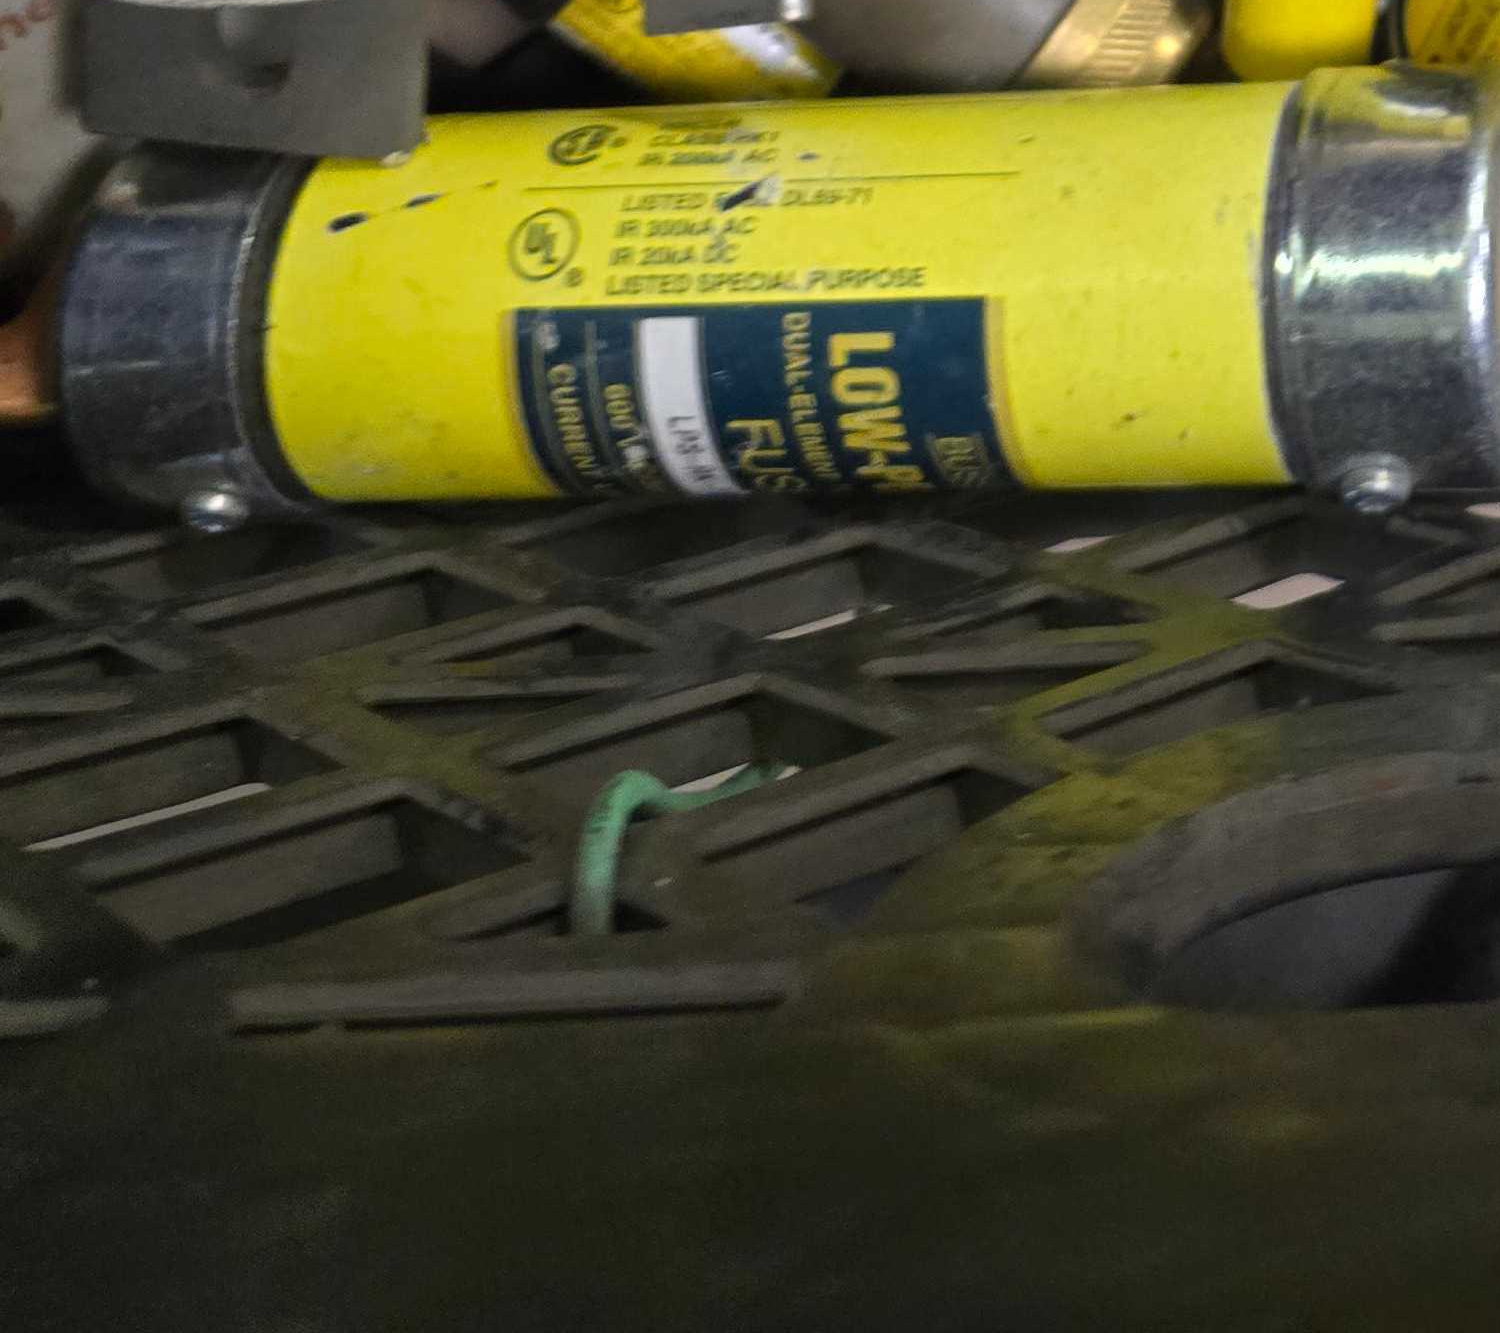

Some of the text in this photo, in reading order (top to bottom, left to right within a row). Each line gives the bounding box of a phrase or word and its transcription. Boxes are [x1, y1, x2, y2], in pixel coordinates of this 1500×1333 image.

[620, 190, 705, 213] LISTED
[721, 215, 760, 235] AC
[604, 264, 928, 296] LISTED SPECIAL PURPOSE
